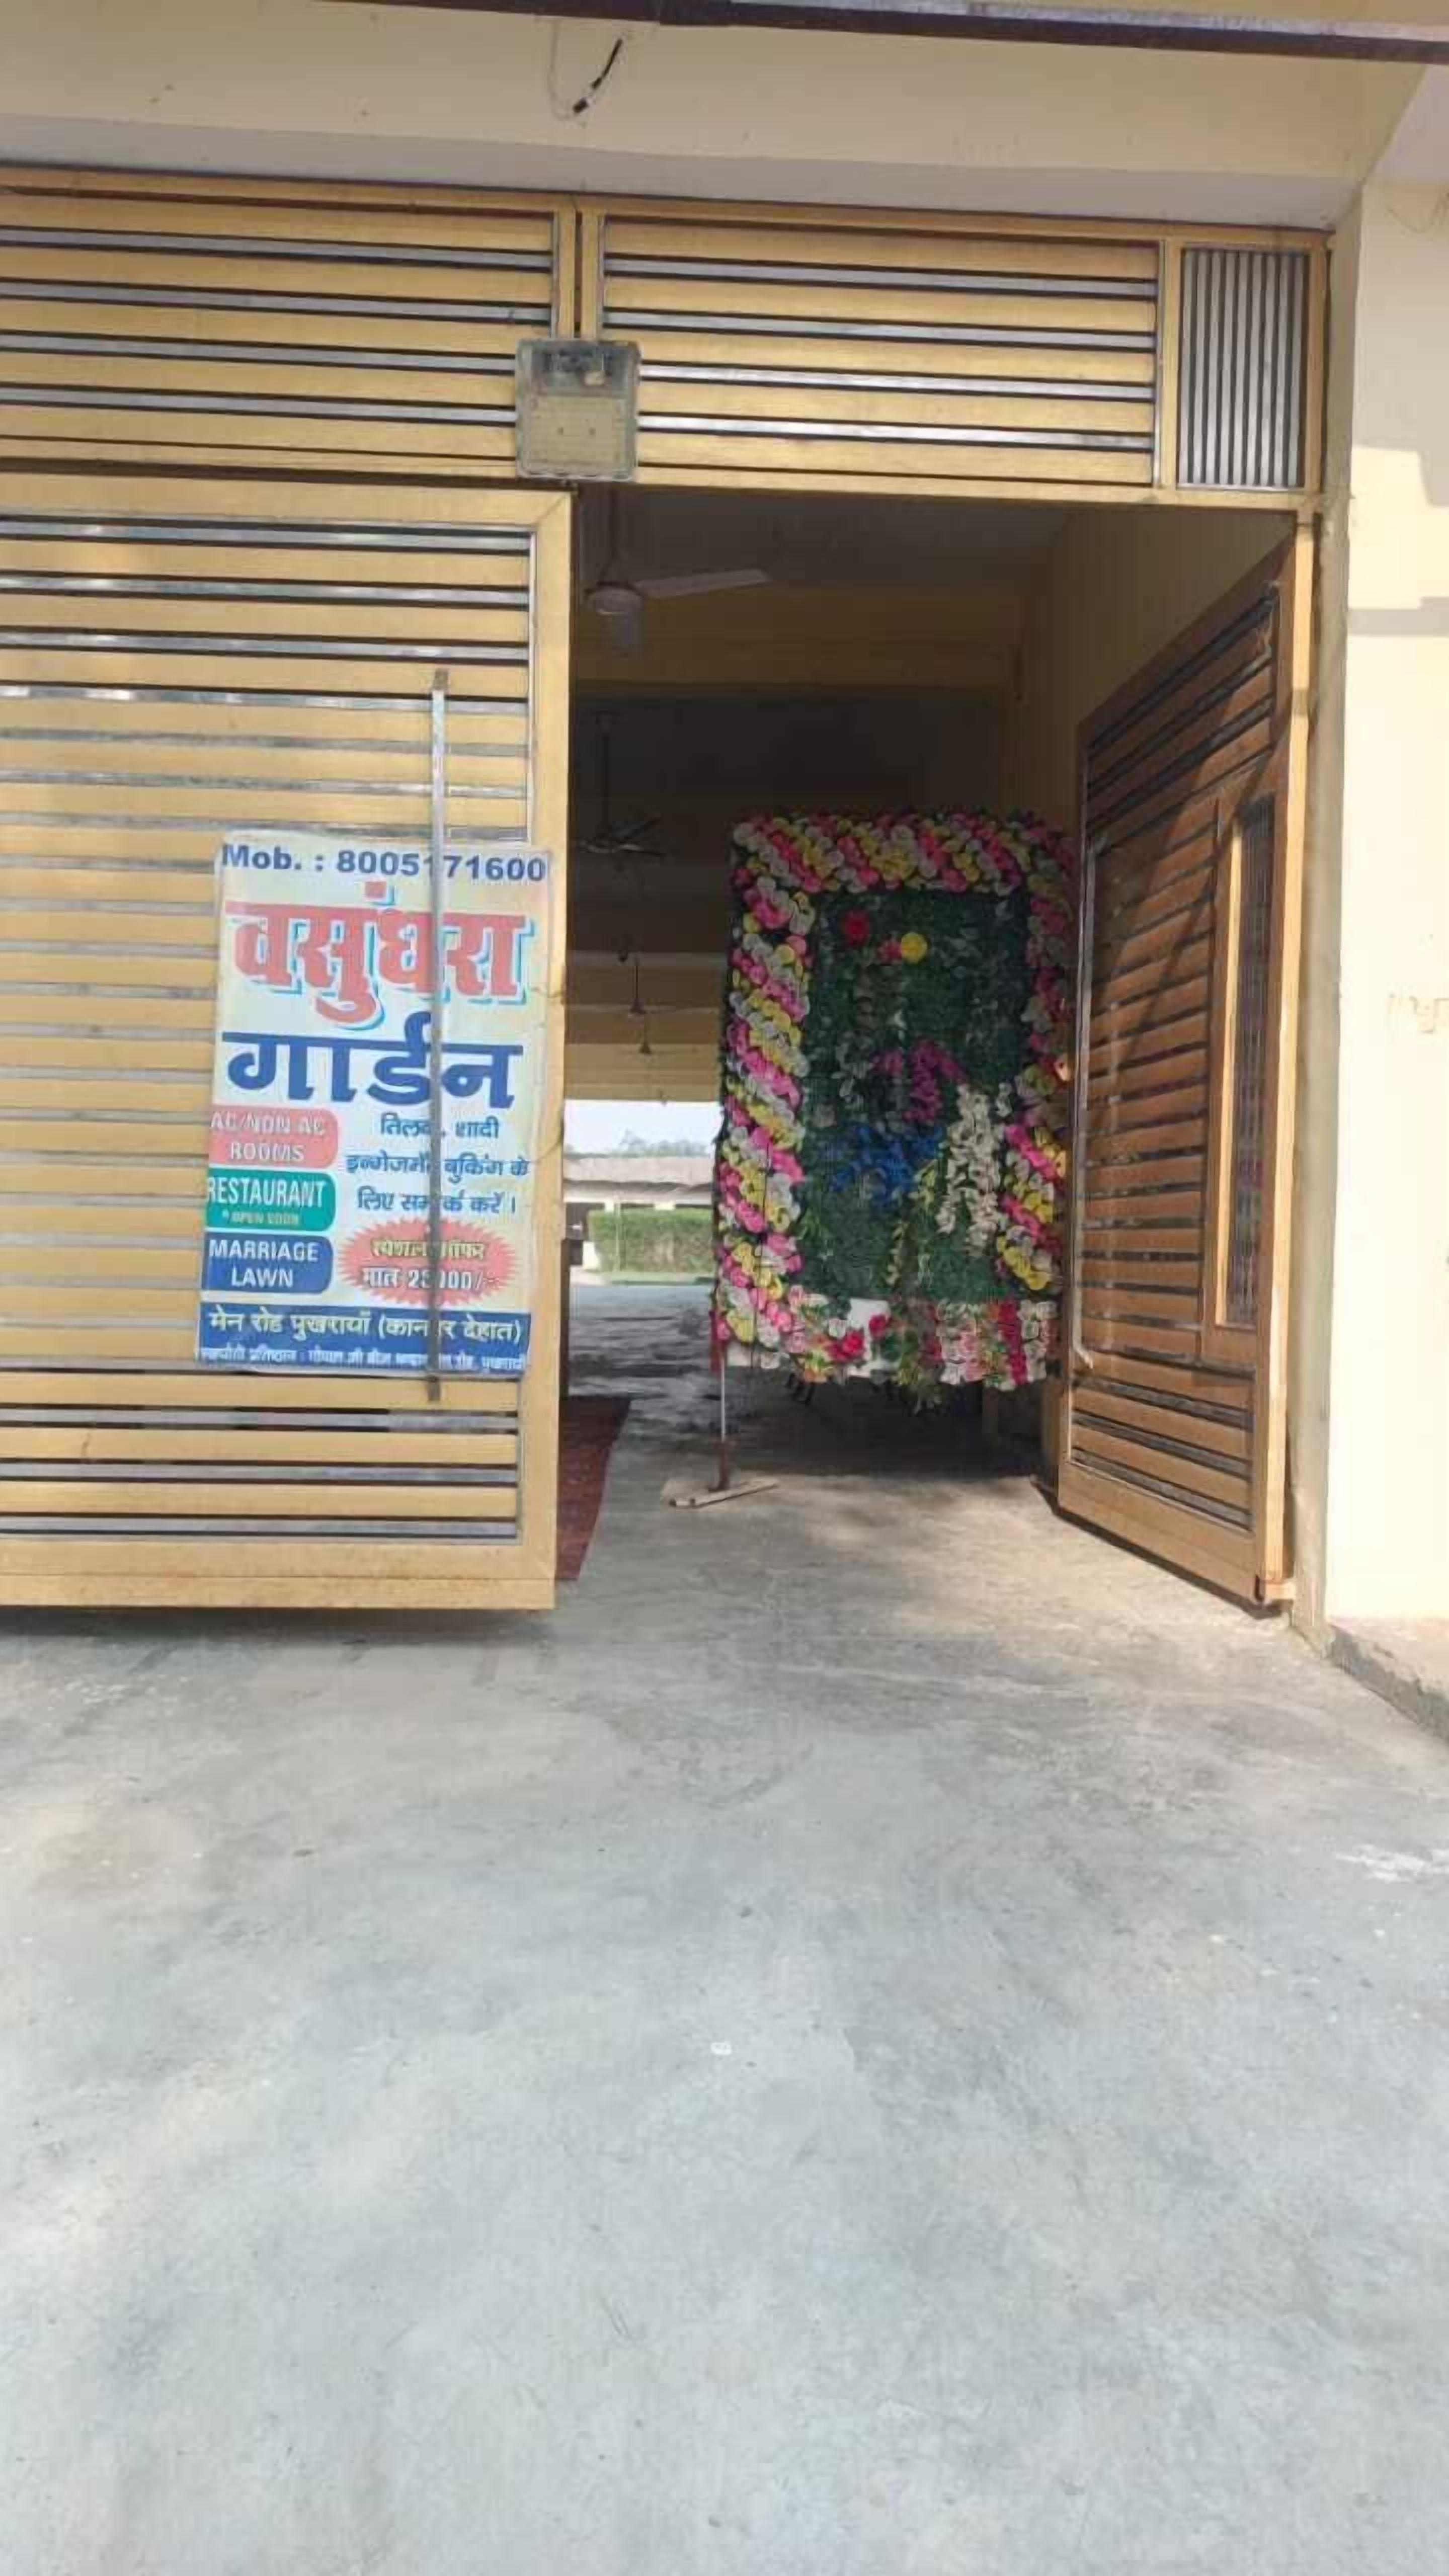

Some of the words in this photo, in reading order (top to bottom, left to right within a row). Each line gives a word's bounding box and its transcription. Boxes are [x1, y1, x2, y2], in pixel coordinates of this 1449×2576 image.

[222, 843, 302, 870] Mob.
[337, 850, 546, 882] 8005171600
[225, 880, 535, 1030] वसुंधरा
[222, 1010, 524, 1109] गार्डन
[455, 1115, 499, 1139] शादी
[230, 1142, 305, 1162] ROOMS
[207, 1176, 326, 1208] RESTAURANT
[357, 1185, 394, 1211] लिए
[208, 1239, 319, 1262] MARRIAGE
[230, 1268, 294, 1288] LAWN
[209, 1304, 246, 1332] मेन
[250, 1306, 284, 1334] रोड
